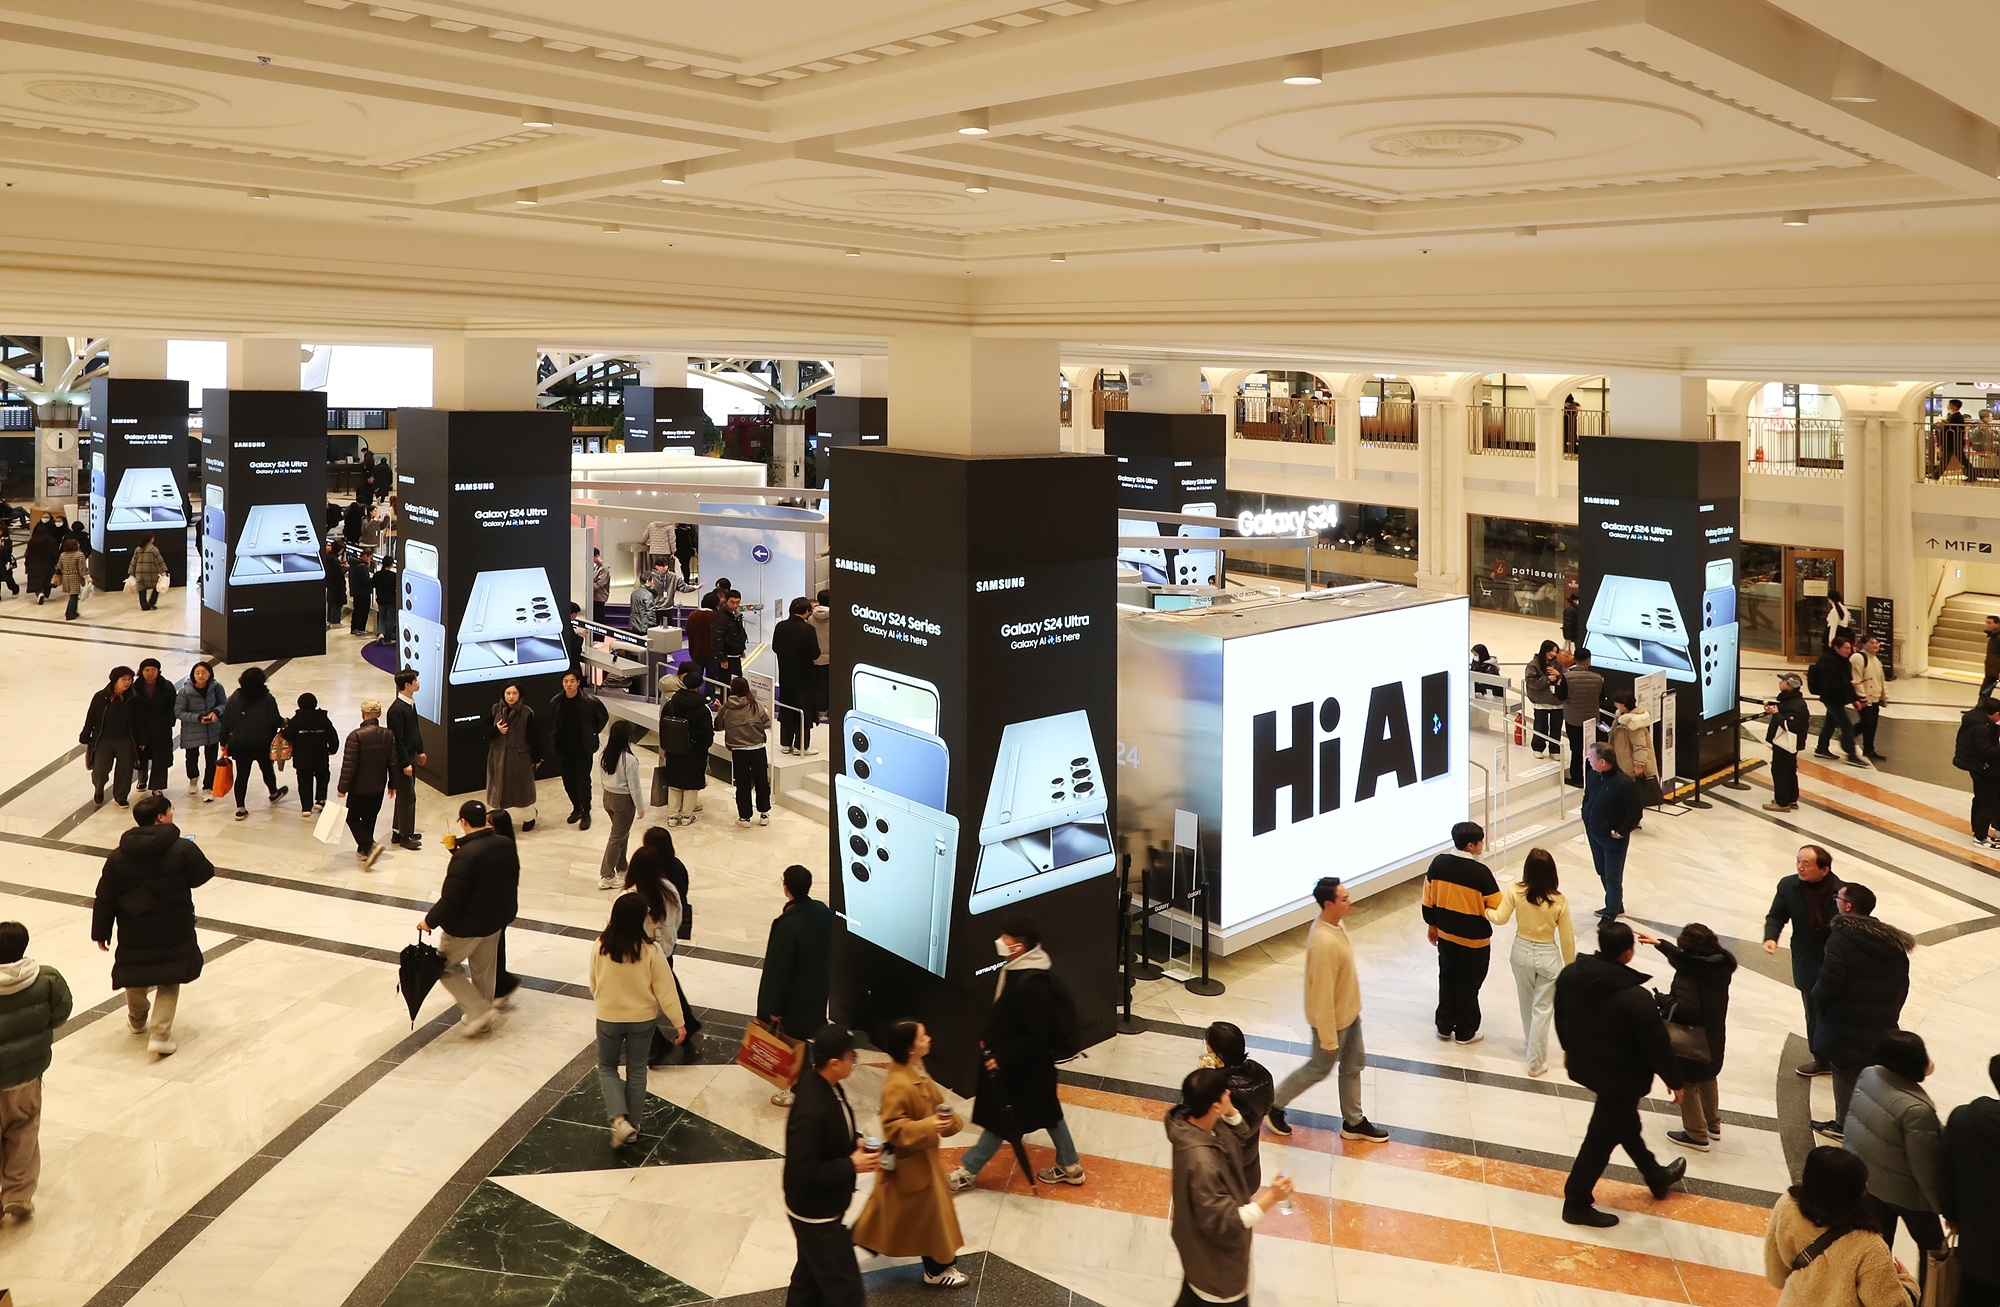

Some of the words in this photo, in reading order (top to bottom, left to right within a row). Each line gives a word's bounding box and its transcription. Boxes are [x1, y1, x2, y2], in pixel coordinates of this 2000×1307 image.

[249, 461, 276, 469] Galaxy
[454, 482, 495, 491] SAMSUNG
[1583, 496, 1620, 506] SAMSUNG
[474, 510, 508, 520] Galaxy
[509, 509, 526, 518] S24
[526, 508, 547, 517] Ultra
[482, 520, 505, 528] Galaxy
[1238, 508, 1307, 538] Galaxy
[1307, 504, 1338, 530] S24
[1601, 521, 1633, 533] Galaxy
[1634, 524, 1649, 534] S24
[1650, 526, 1673, 536] Ultra
[1608, 531, 1630, 541] Galaxy
[1649, 535, 1665, 543] here
[1945, 540, 1977, 552] M1F
[835, 557, 876, 575] SAMSUNG
[1512, 567, 1565, 580] patisseri
[976, 576, 1025, 593] SAMSUNG
[851, 604, 888, 626] Galaxy
[888, 612, 907, 628] S24
[907, 616, 942, 636] Series
[1001, 621, 1042, 637] Galaxy
[1043, 616, 1063, 631] S24
[1064, 614, 1090, 628] Ultra
[863, 623, 888, 639] Galaxy
[888, 629, 896, 639] AI
[902, 633, 909, 642] is
[910, 634, 928, 647] here
[1010, 638, 1039, 650] Galaxy
[1039, 637, 1047, 646] AI
[1055, 635, 1062, 643] is
[1062, 632, 1081, 642] here
[1253, 696, 1341, 837] Hi
[1354, 670, 1450, 803] AI
[1187, 888, 1202, 899] Galaxy
[1154, 902, 1170, 912] Galaxy
